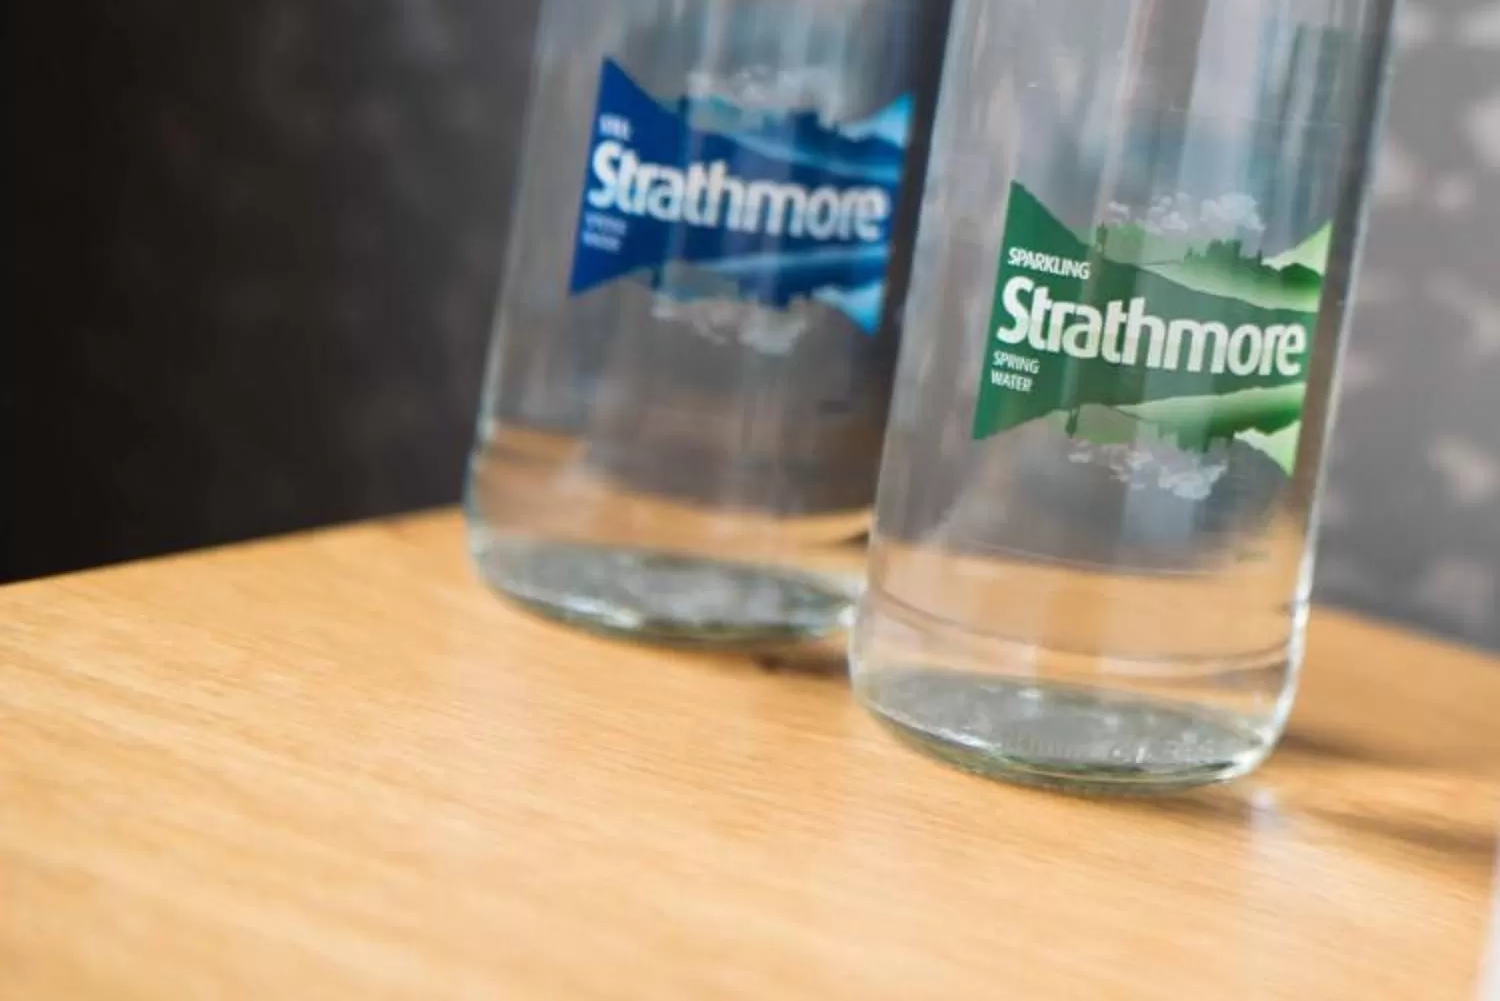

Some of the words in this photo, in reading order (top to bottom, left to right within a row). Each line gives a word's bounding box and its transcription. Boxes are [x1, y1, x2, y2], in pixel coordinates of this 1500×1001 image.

[588, 141, 888, 240] Strathmore
[1007, 247, 1091, 279] SPARKLING
[997, 276, 1305, 376] Strathmore
[993, 351, 1039, 374] SPRING
[991, 370, 1032, 392] WATER
